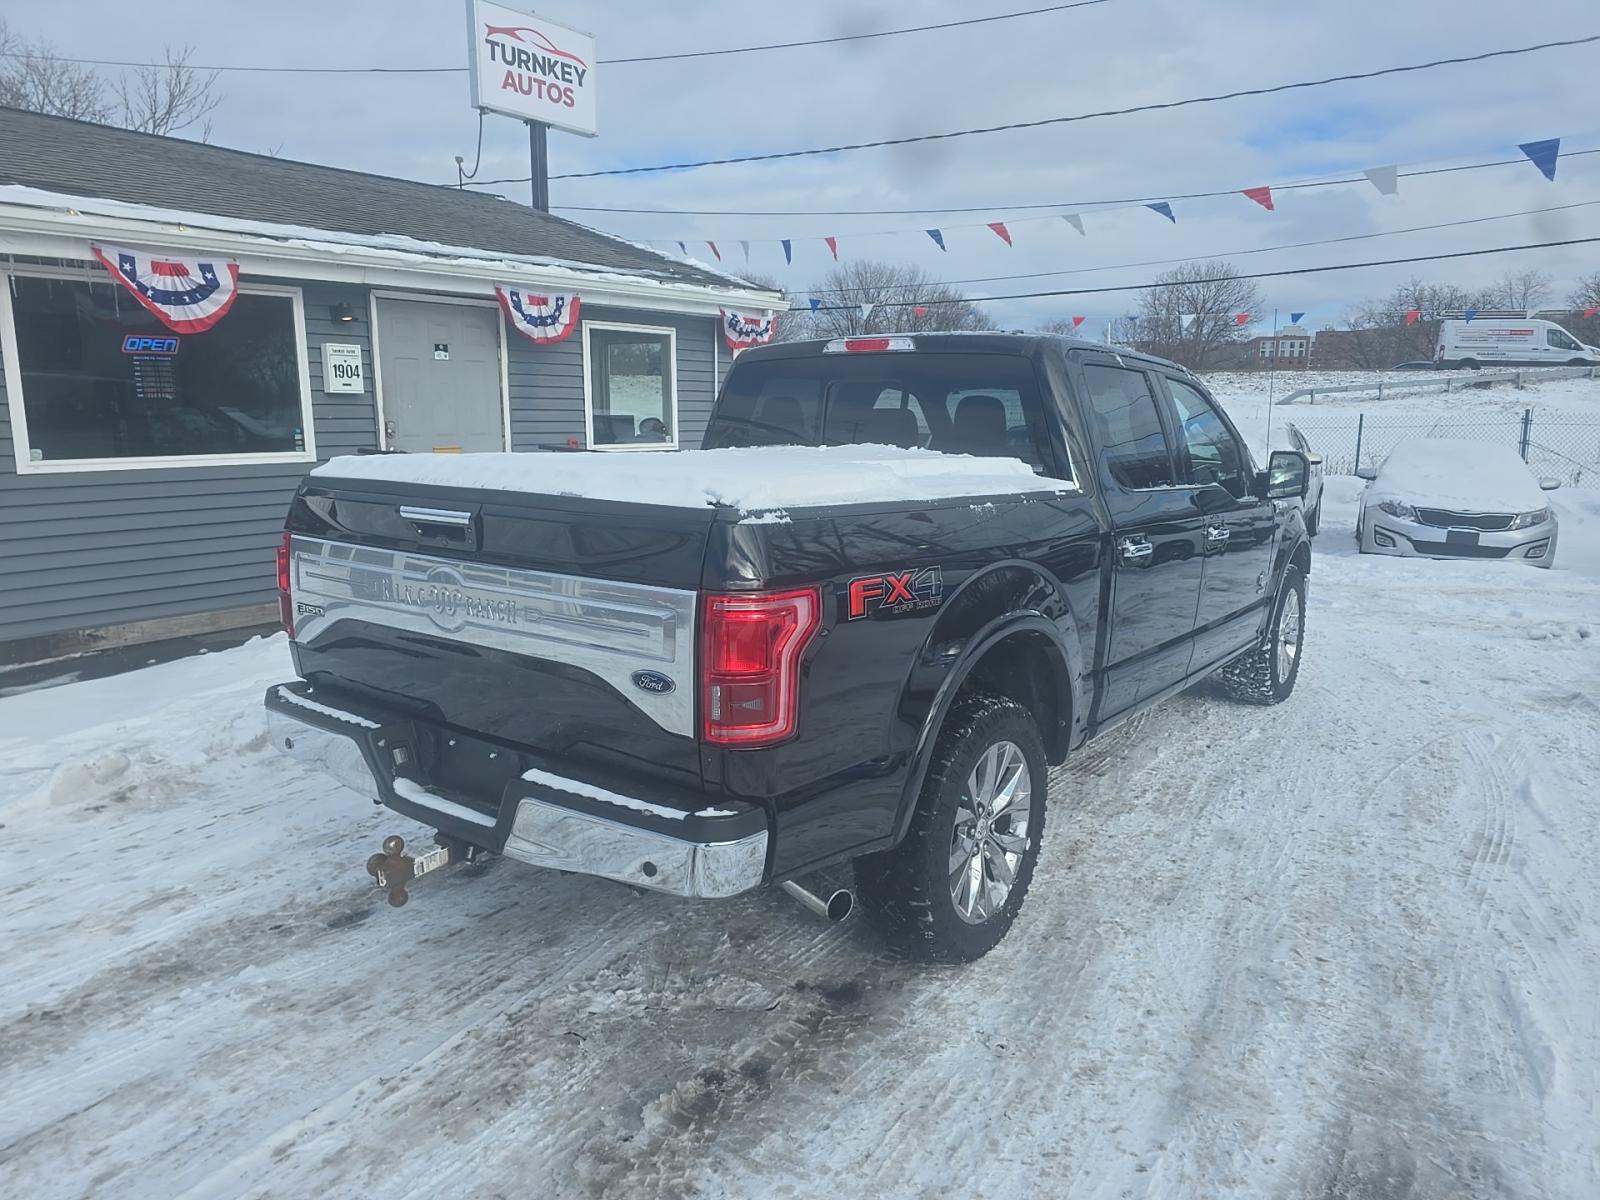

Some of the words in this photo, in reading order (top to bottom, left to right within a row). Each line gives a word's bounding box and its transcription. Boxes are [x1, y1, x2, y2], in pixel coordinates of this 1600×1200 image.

[485, 38, 587, 87] TURNKEY
[502, 69, 575, 108] AUTOS
[125, 338, 177, 351] OPEN
[332, 363, 361, 379] 1904
[848, 565, 943, 621] FX4
[464, 595, 517, 624] RANCH
[638, 674, 664, 691] Ford
